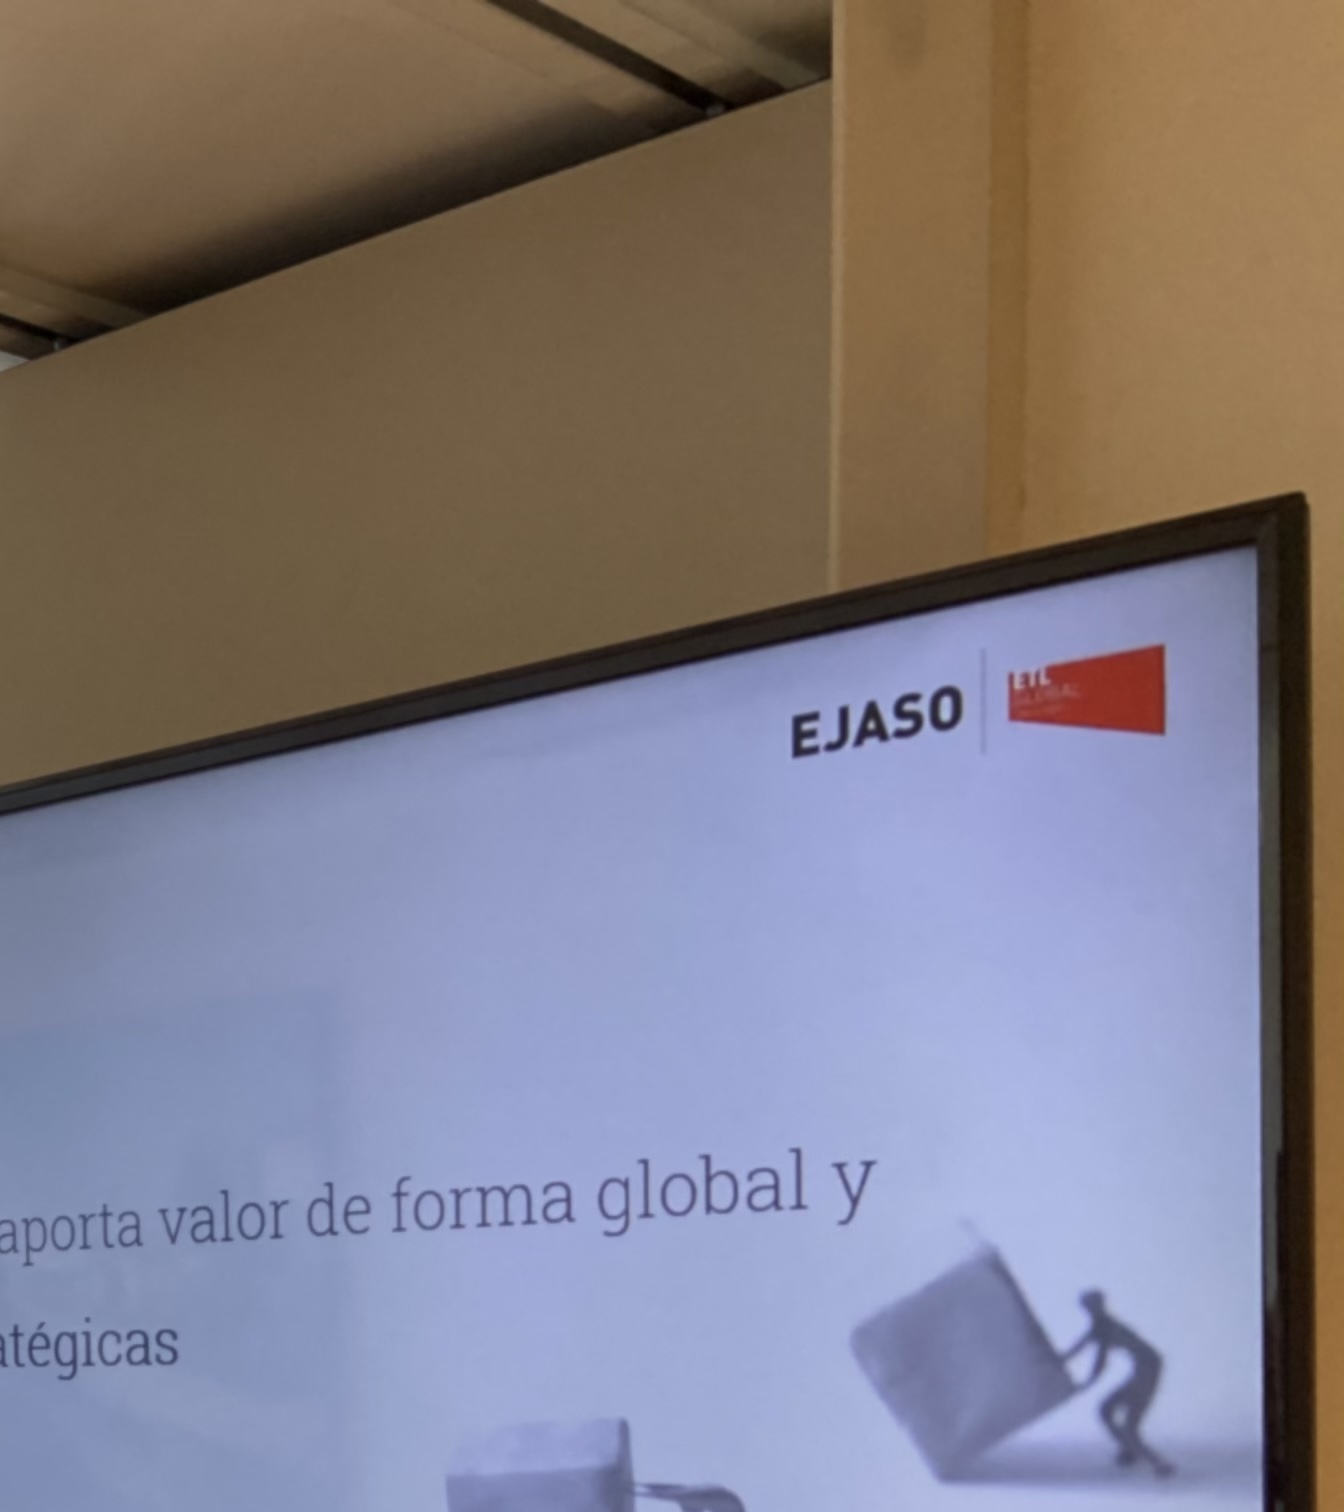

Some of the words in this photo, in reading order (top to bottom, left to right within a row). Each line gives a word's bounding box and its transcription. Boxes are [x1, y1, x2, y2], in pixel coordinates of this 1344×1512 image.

[791, 685, 963, 759] EJASO
[158, 1189, 291, 1245] valor
[306, 1181, 372, 1237] de
[390, 1175, 577, 1234] forma
[597, 1146, 809, 1237] global
[831, 1158, 878, 1226] y
